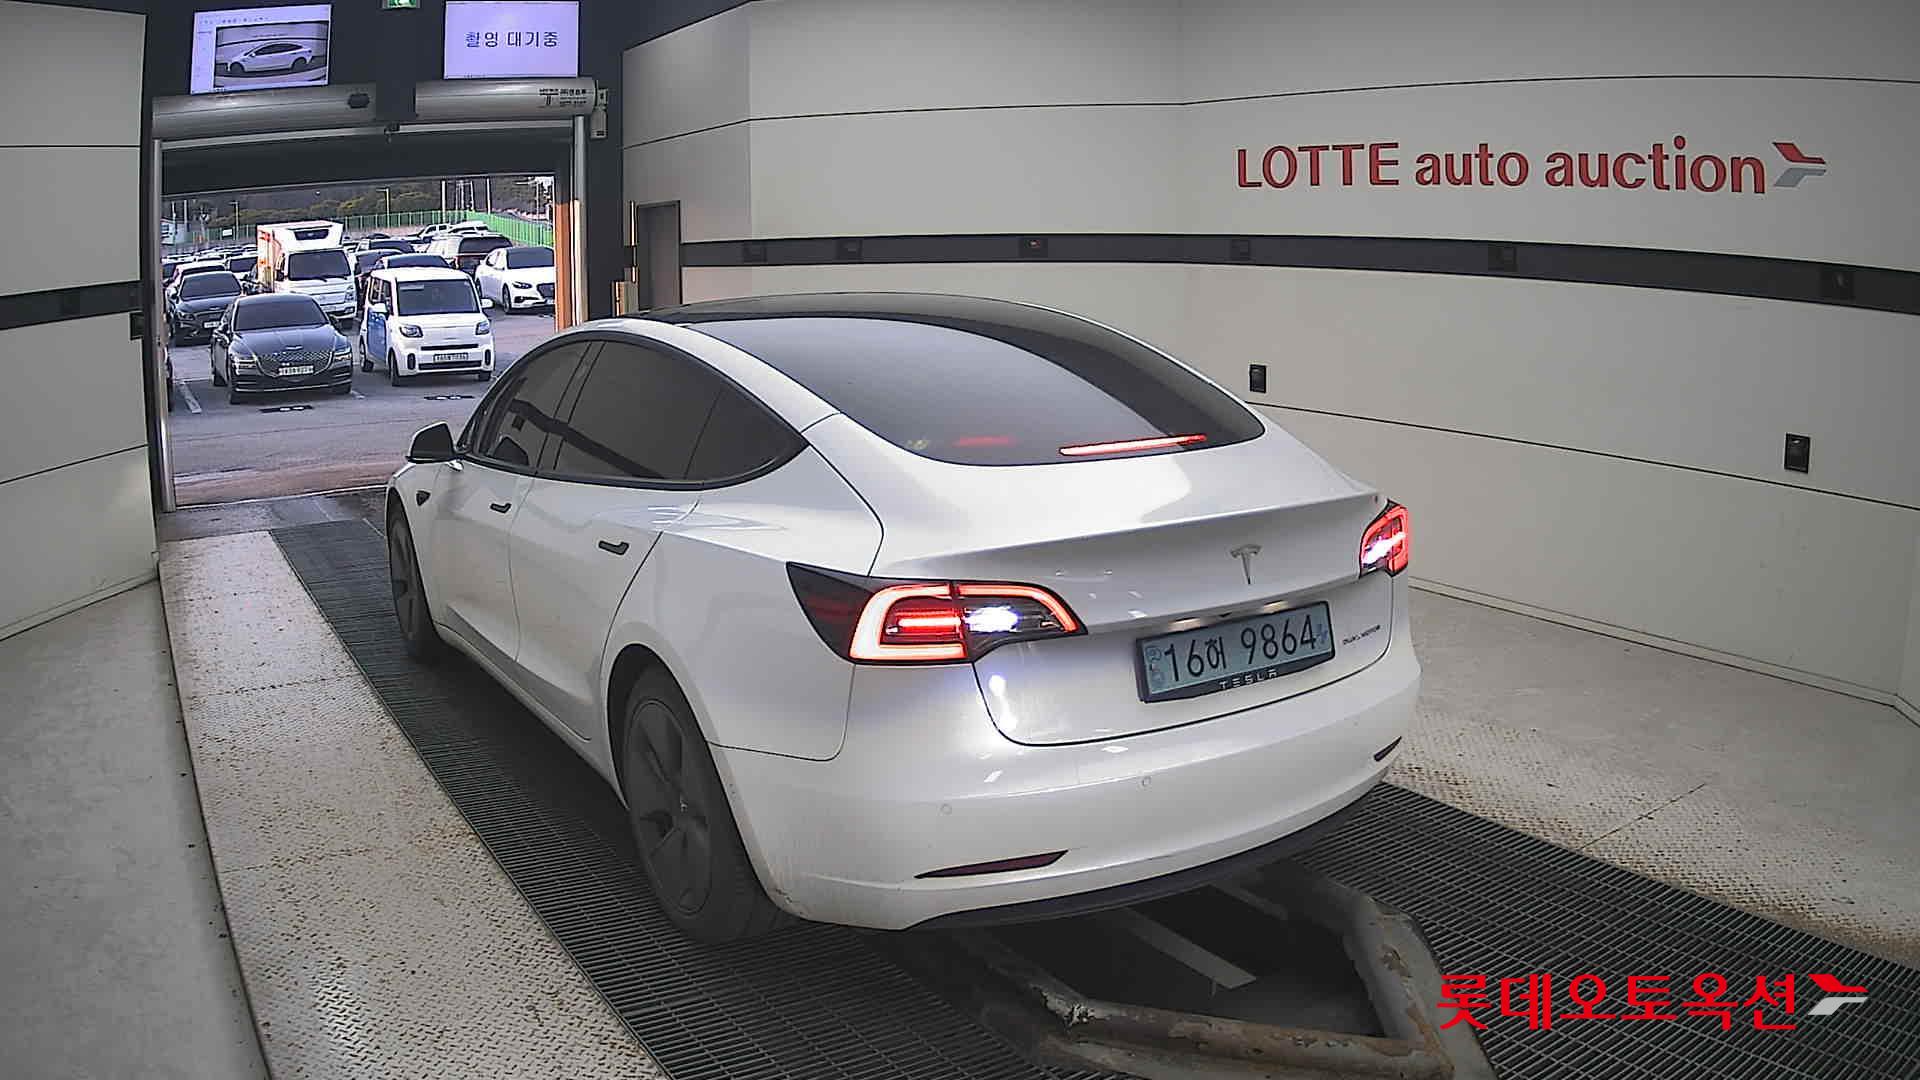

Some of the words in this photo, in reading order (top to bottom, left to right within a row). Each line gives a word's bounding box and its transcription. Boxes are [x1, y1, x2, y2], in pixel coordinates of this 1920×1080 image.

[506, 31, 559, 48] 대기중
[1237, 142, 1400, 188] LOTTE
[1415, 143, 1529, 187] auto
[1545, 135, 1766, 194] auction
[1164, 636, 1227, 682] 16허
[1240, 614, 1317, 665] 9864
[1219, 669, 1277, 690] TESLA
